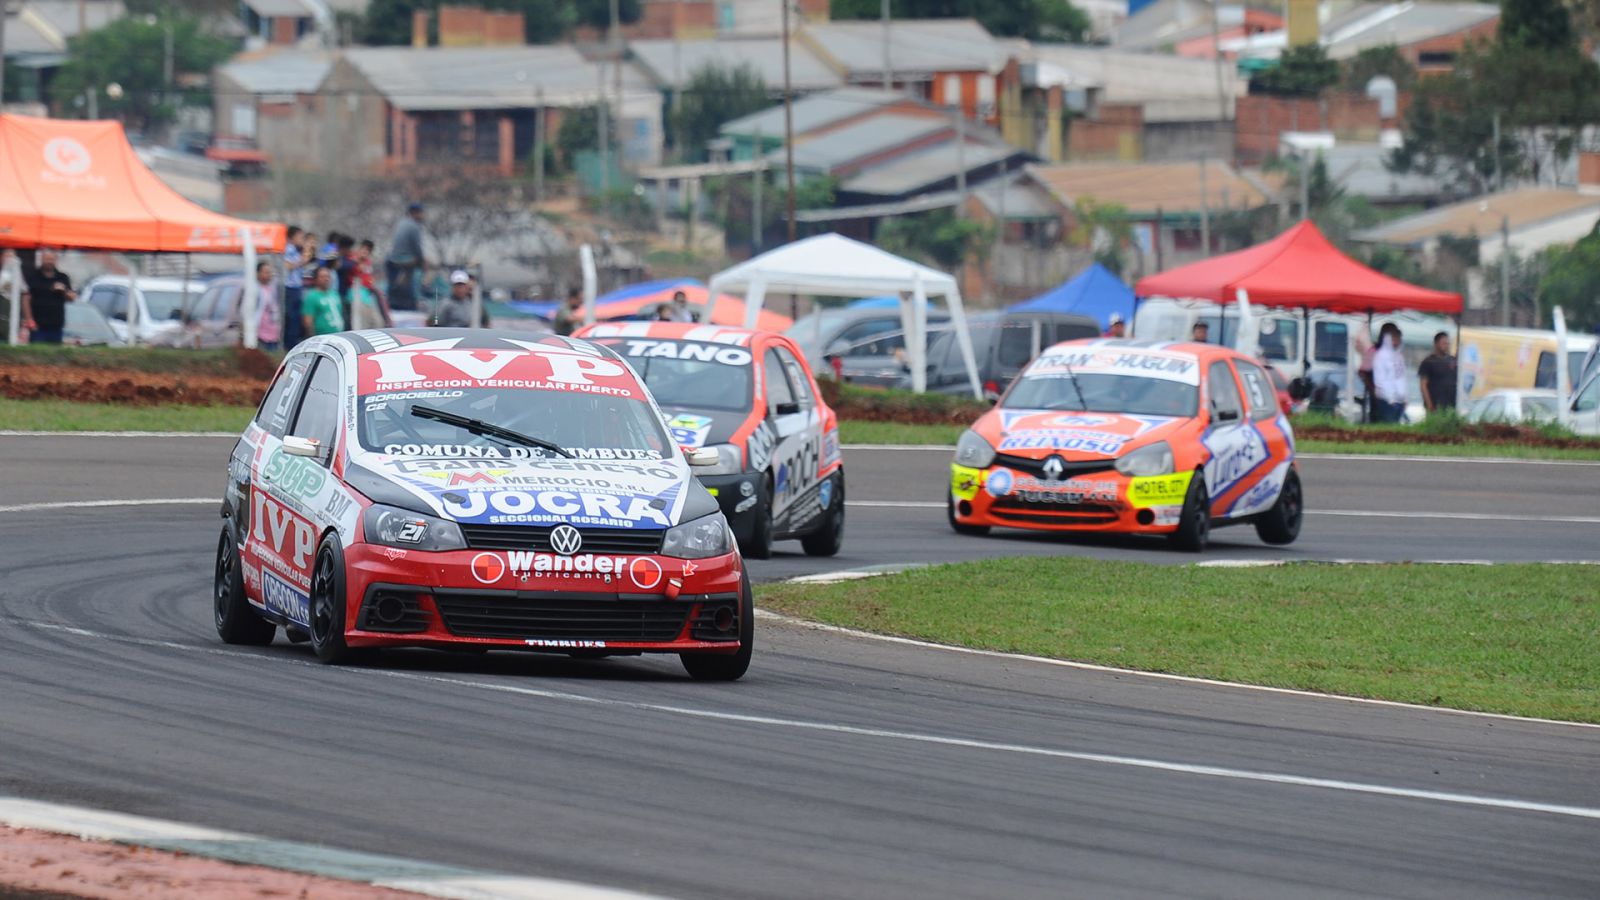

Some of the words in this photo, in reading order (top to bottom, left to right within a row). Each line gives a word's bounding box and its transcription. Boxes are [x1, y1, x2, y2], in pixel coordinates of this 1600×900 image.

[627, 340, 752, 366] TANO
[367, 350, 624, 384] IVP
[376, 379, 472, 391] INSPECCION
[475, 379, 566, 391] VEHICULAR
[570, 383, 631, 396] PUERTO
[365, 390, 463, 404] BORGOBELLO
[366, 402, 387, 412] C2
[384, 443, 505, 459] COMUNA
[508, 446, 546, 460] DE
[555, 446, 664, 462] IMBUES
[502, 475, 611, 488] MEROCIO
[442, 490, 670, 526] JOCRA
[253, 491, 316, 569] IVP
[490, 515, 568, 524] SECCIONAL
[570, 516, 633, 528] ROSARIO
[398, 523, 425, 541] 21
[507, 551, 627, 573] Wander
